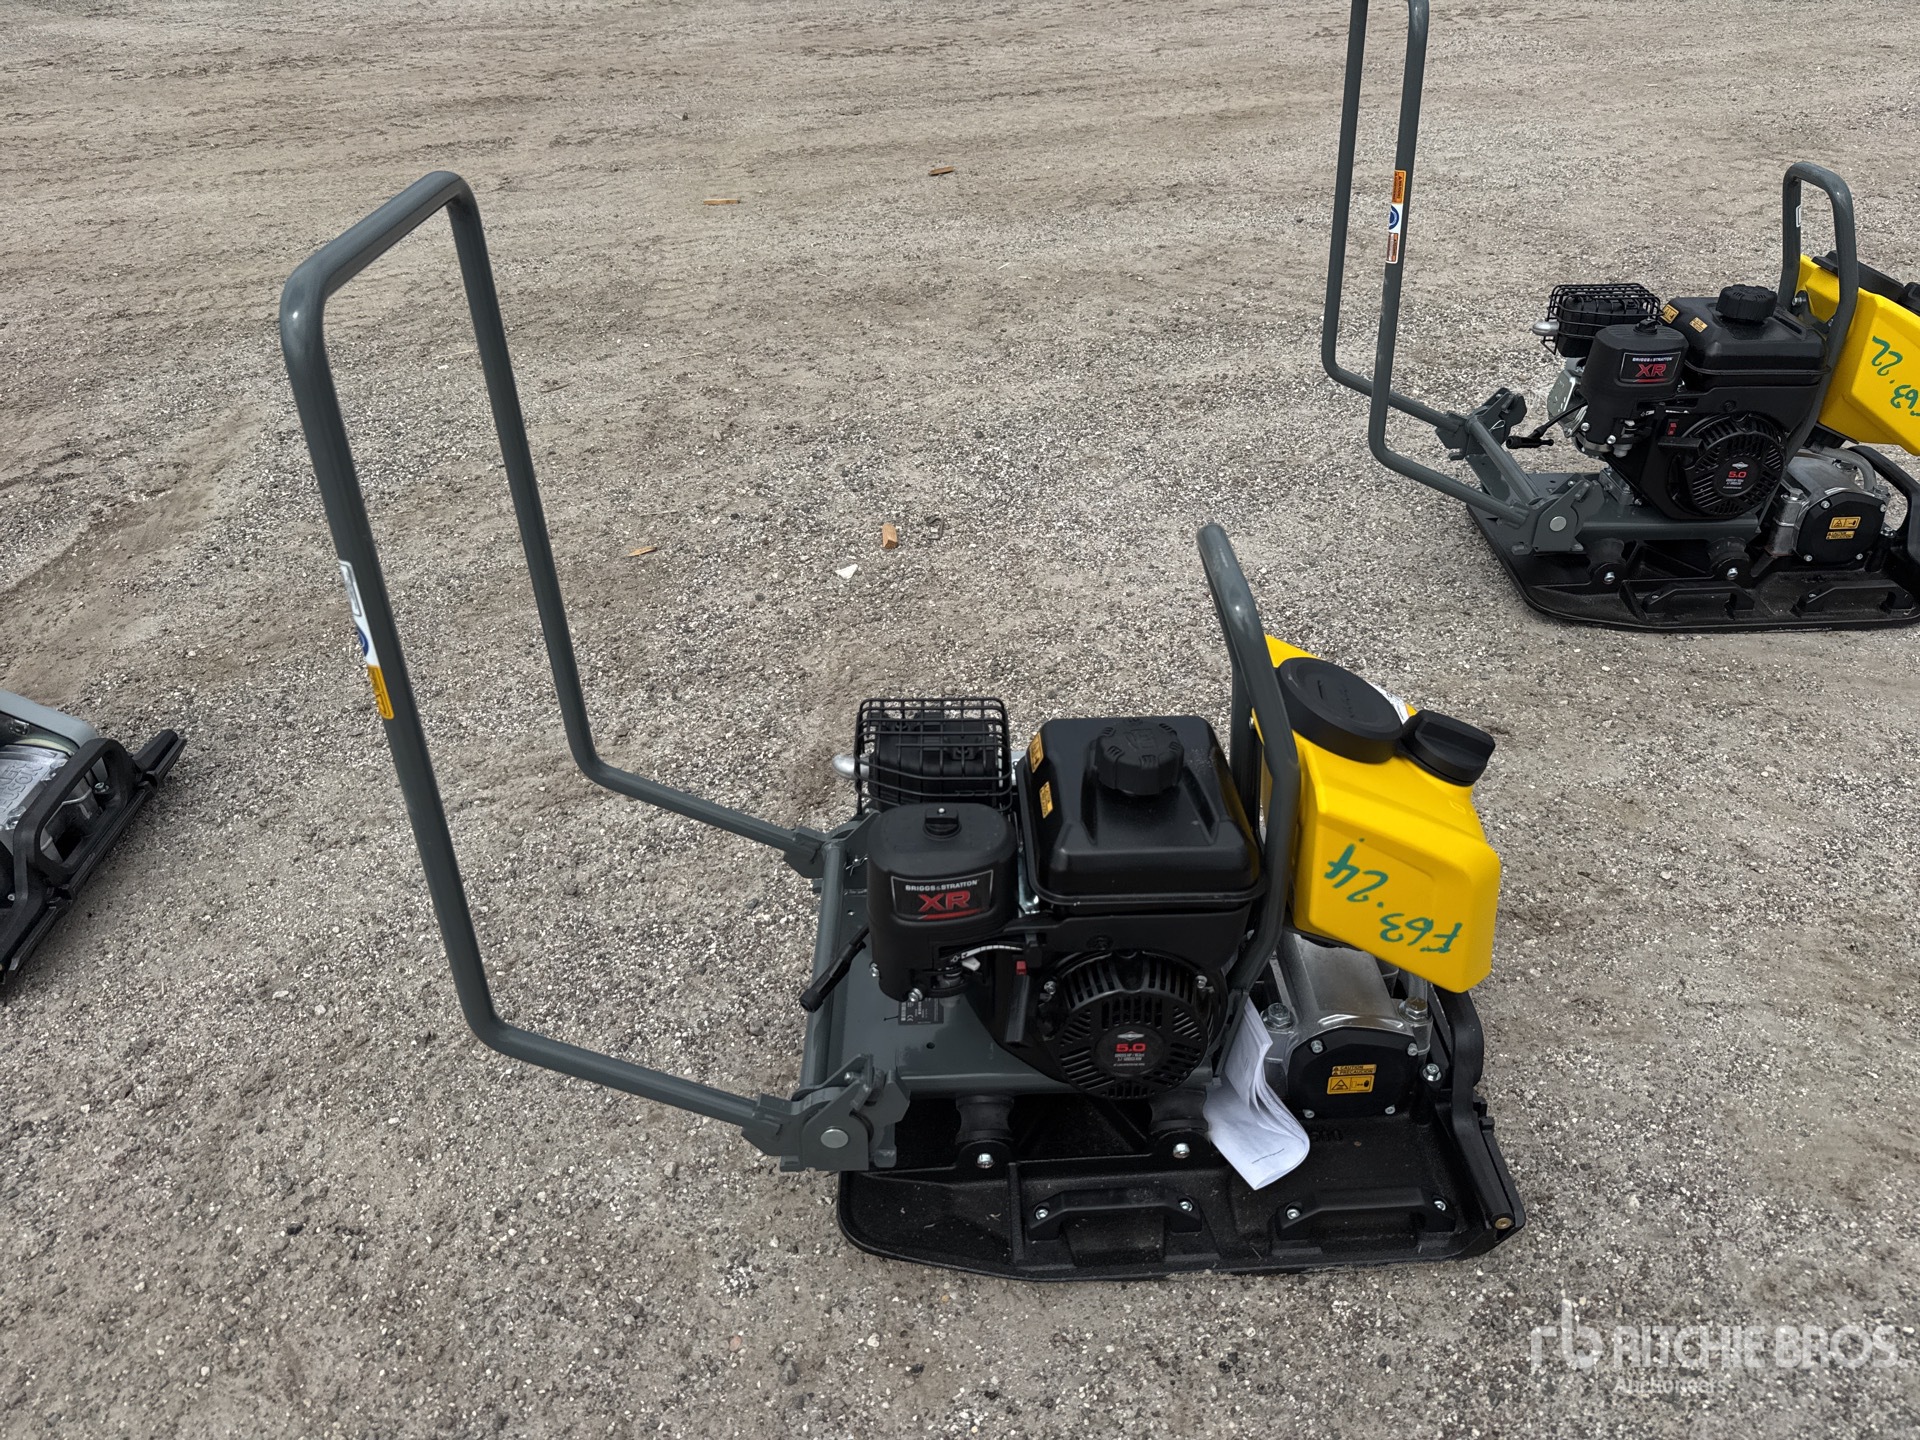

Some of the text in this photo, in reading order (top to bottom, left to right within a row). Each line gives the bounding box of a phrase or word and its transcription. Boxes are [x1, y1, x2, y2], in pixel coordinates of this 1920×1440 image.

[1635, 363, 1667, 378] XR
[1871, 335, 1920, 416] 63.22
[918, 890, 971, 912] XR
[1116, 1043, 1146, 1052] 5.0
